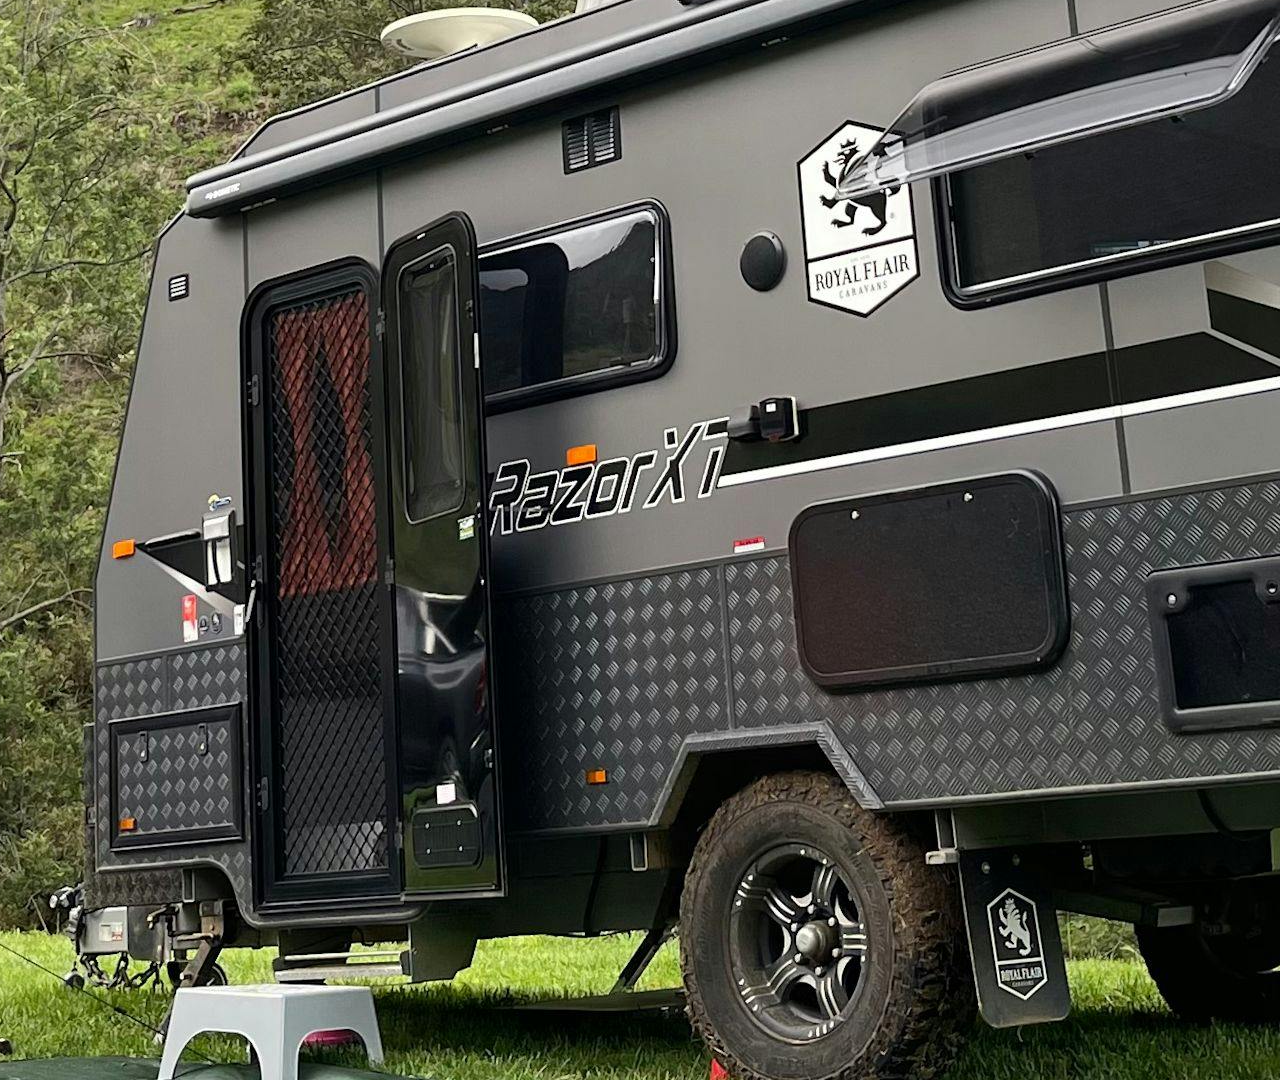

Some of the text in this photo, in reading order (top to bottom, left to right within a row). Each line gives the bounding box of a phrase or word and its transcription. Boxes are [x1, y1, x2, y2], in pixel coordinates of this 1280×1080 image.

[815, 254, 910, 291] ROYAL FLAIR
[839, 281, 888, 299] CARAVANS
